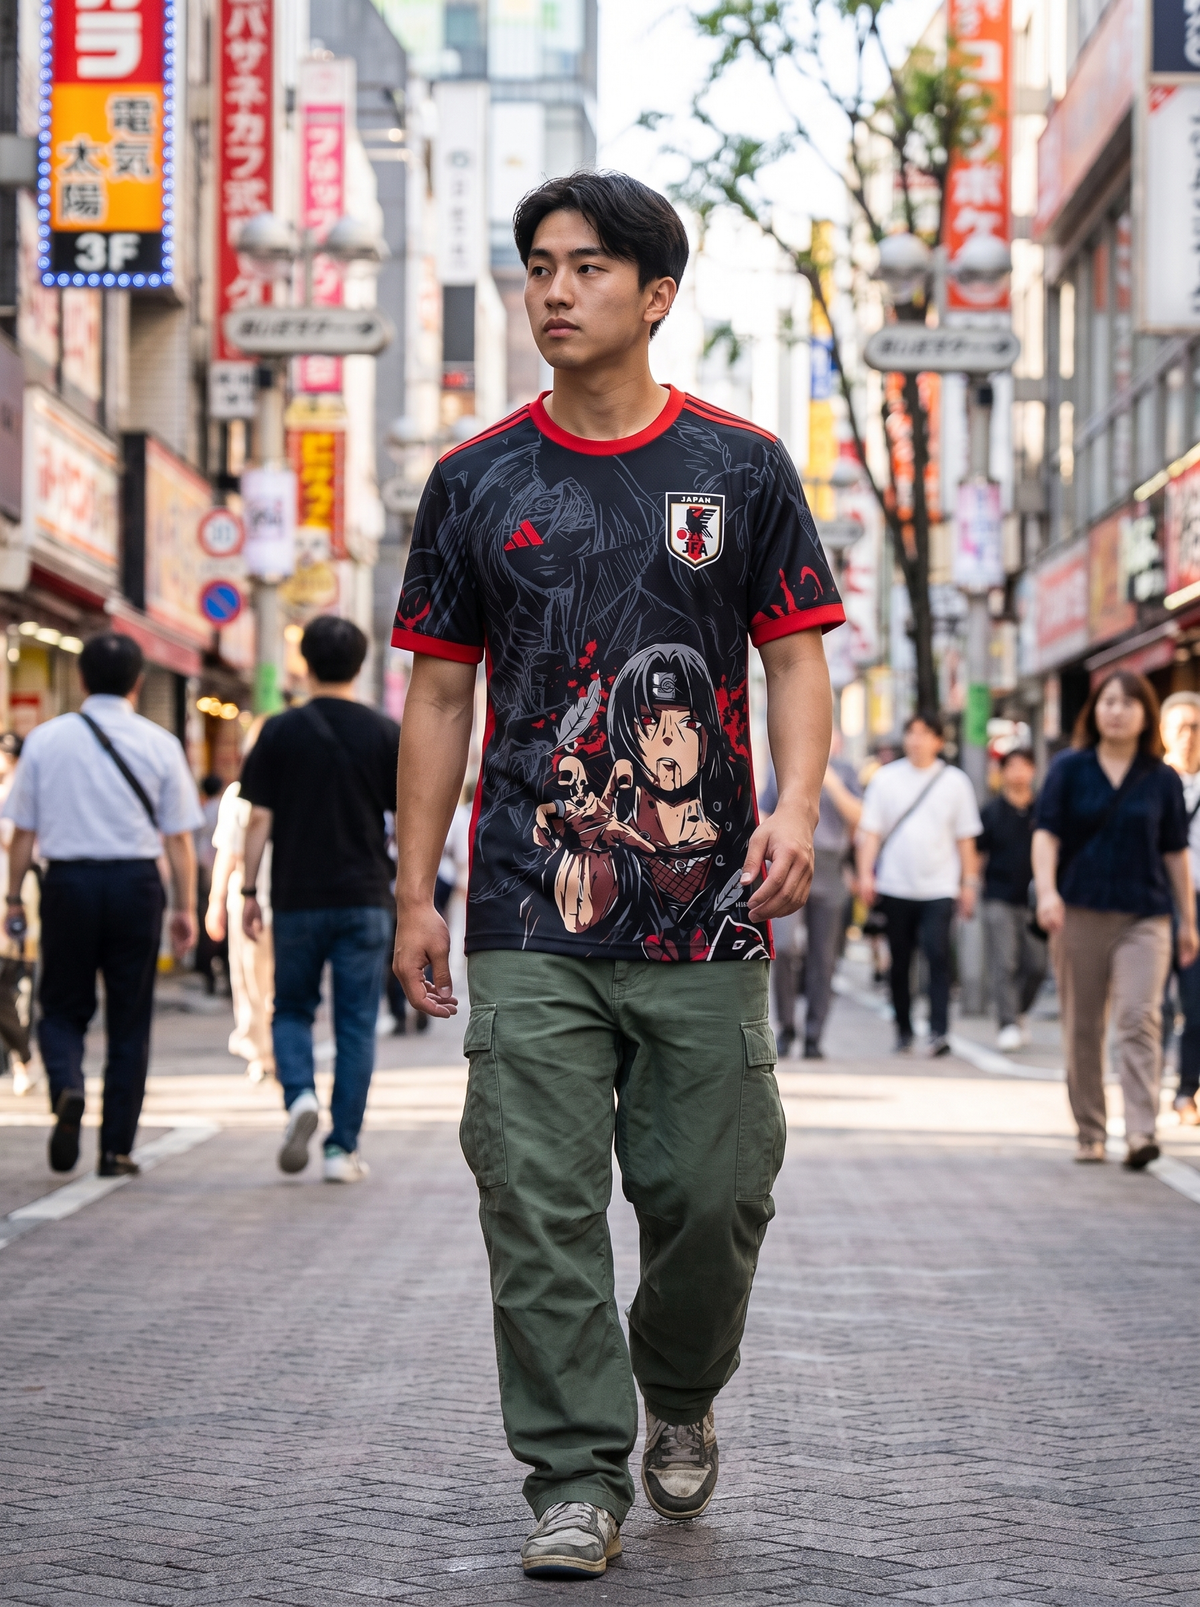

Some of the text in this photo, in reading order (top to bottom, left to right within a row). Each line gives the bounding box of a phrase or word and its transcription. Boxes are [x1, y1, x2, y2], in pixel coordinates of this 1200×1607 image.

[109, 96, 155, 178] 電気
[60, 140, 103, 221] 太陽
[74, 232, 141, 272] 3F
[681, 496, 711, 504] JAPAN
[682, 541, 708, 557] JFA
